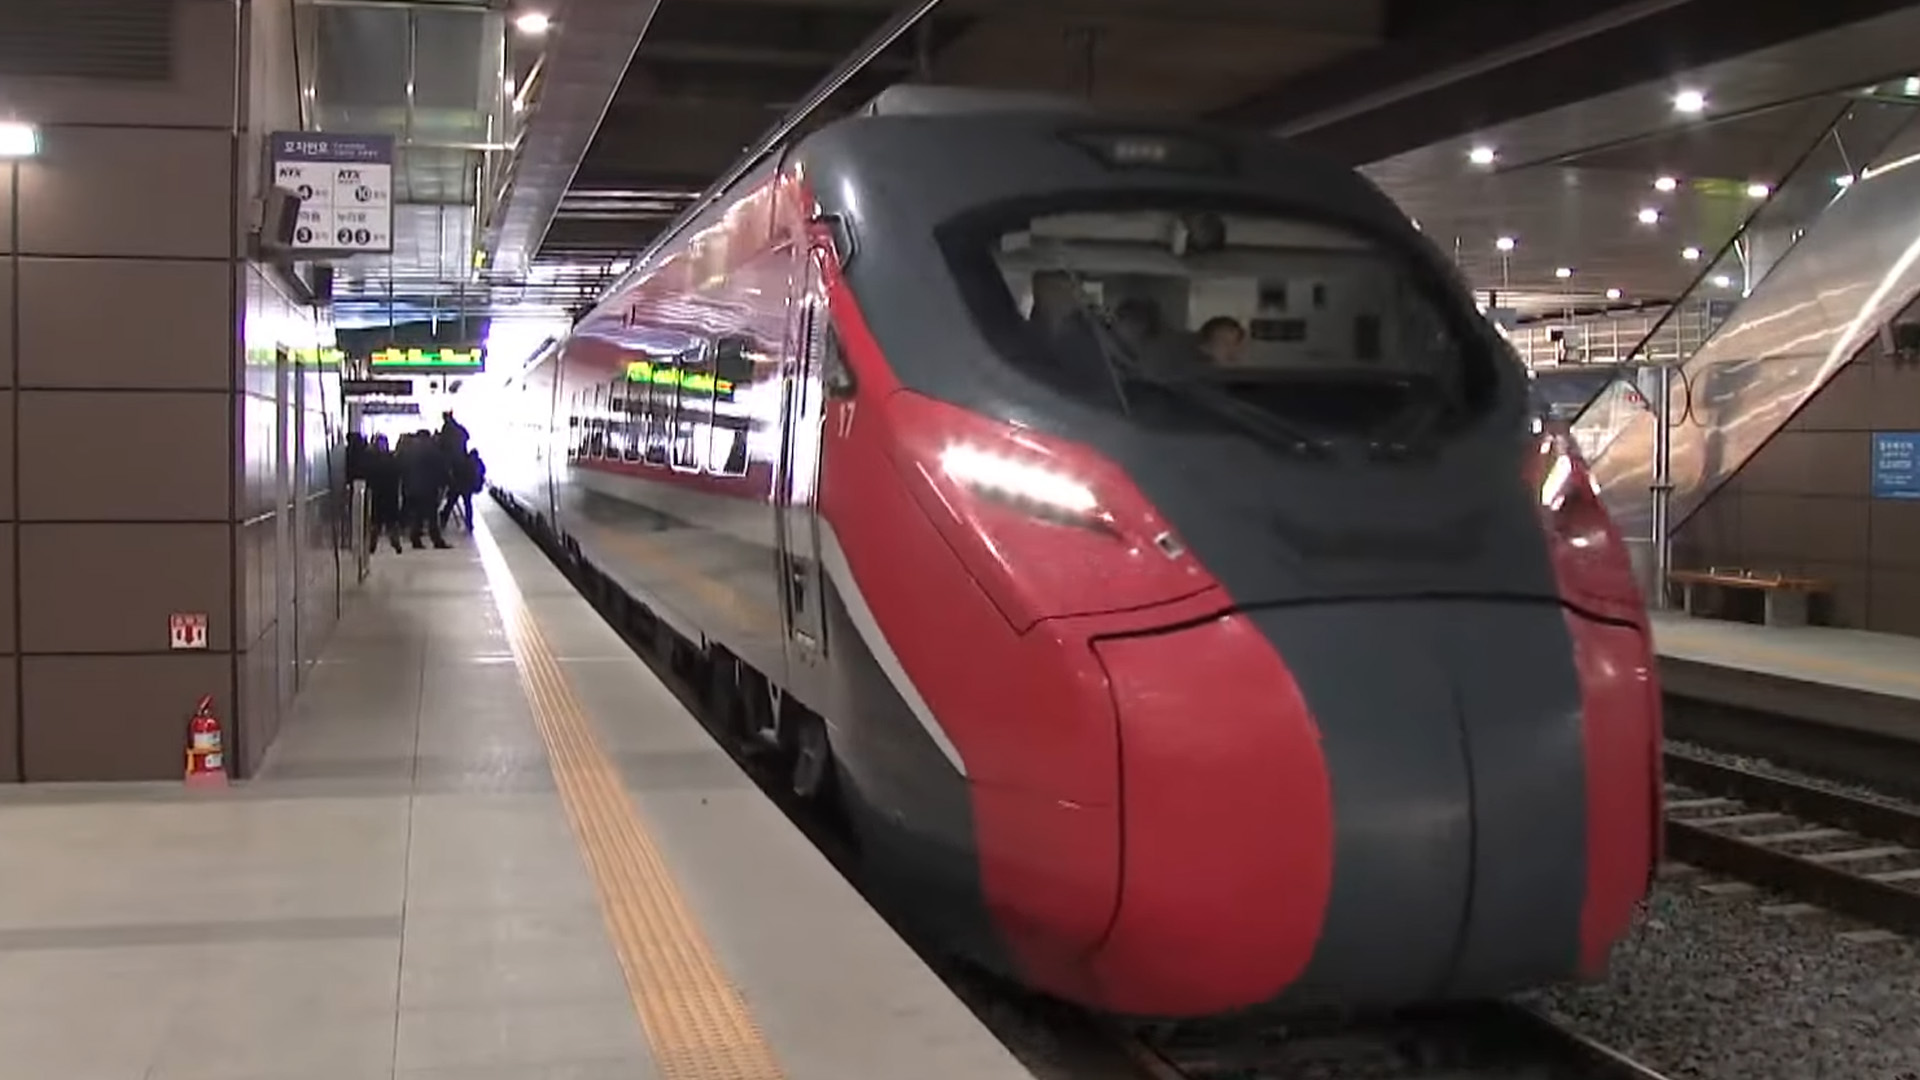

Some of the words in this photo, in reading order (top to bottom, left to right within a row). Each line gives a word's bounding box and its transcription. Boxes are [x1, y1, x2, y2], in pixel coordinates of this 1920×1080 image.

[279, 168, 301, 178] KTX
[337, 169, 360, 179] KTX
[356, 186, 371, 200] 10
[838, 400, 856, 440] 17
